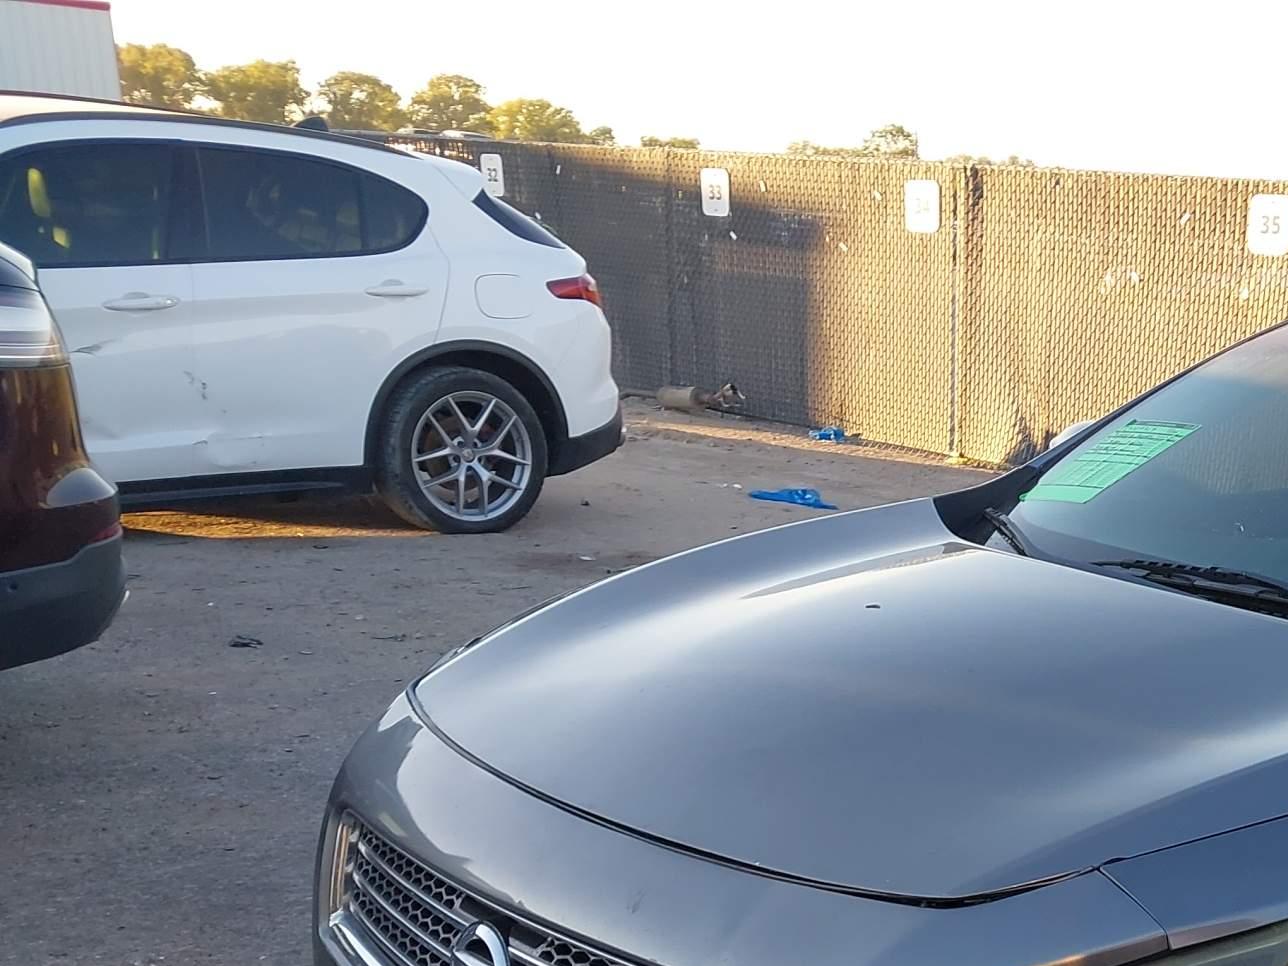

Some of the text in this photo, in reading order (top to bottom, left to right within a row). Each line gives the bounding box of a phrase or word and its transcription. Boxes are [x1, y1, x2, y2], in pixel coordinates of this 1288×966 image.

[487, 167, 498, 183] 32
[708, 184, 722, 201] 33
[1260, 215, 1281, 235] 35
